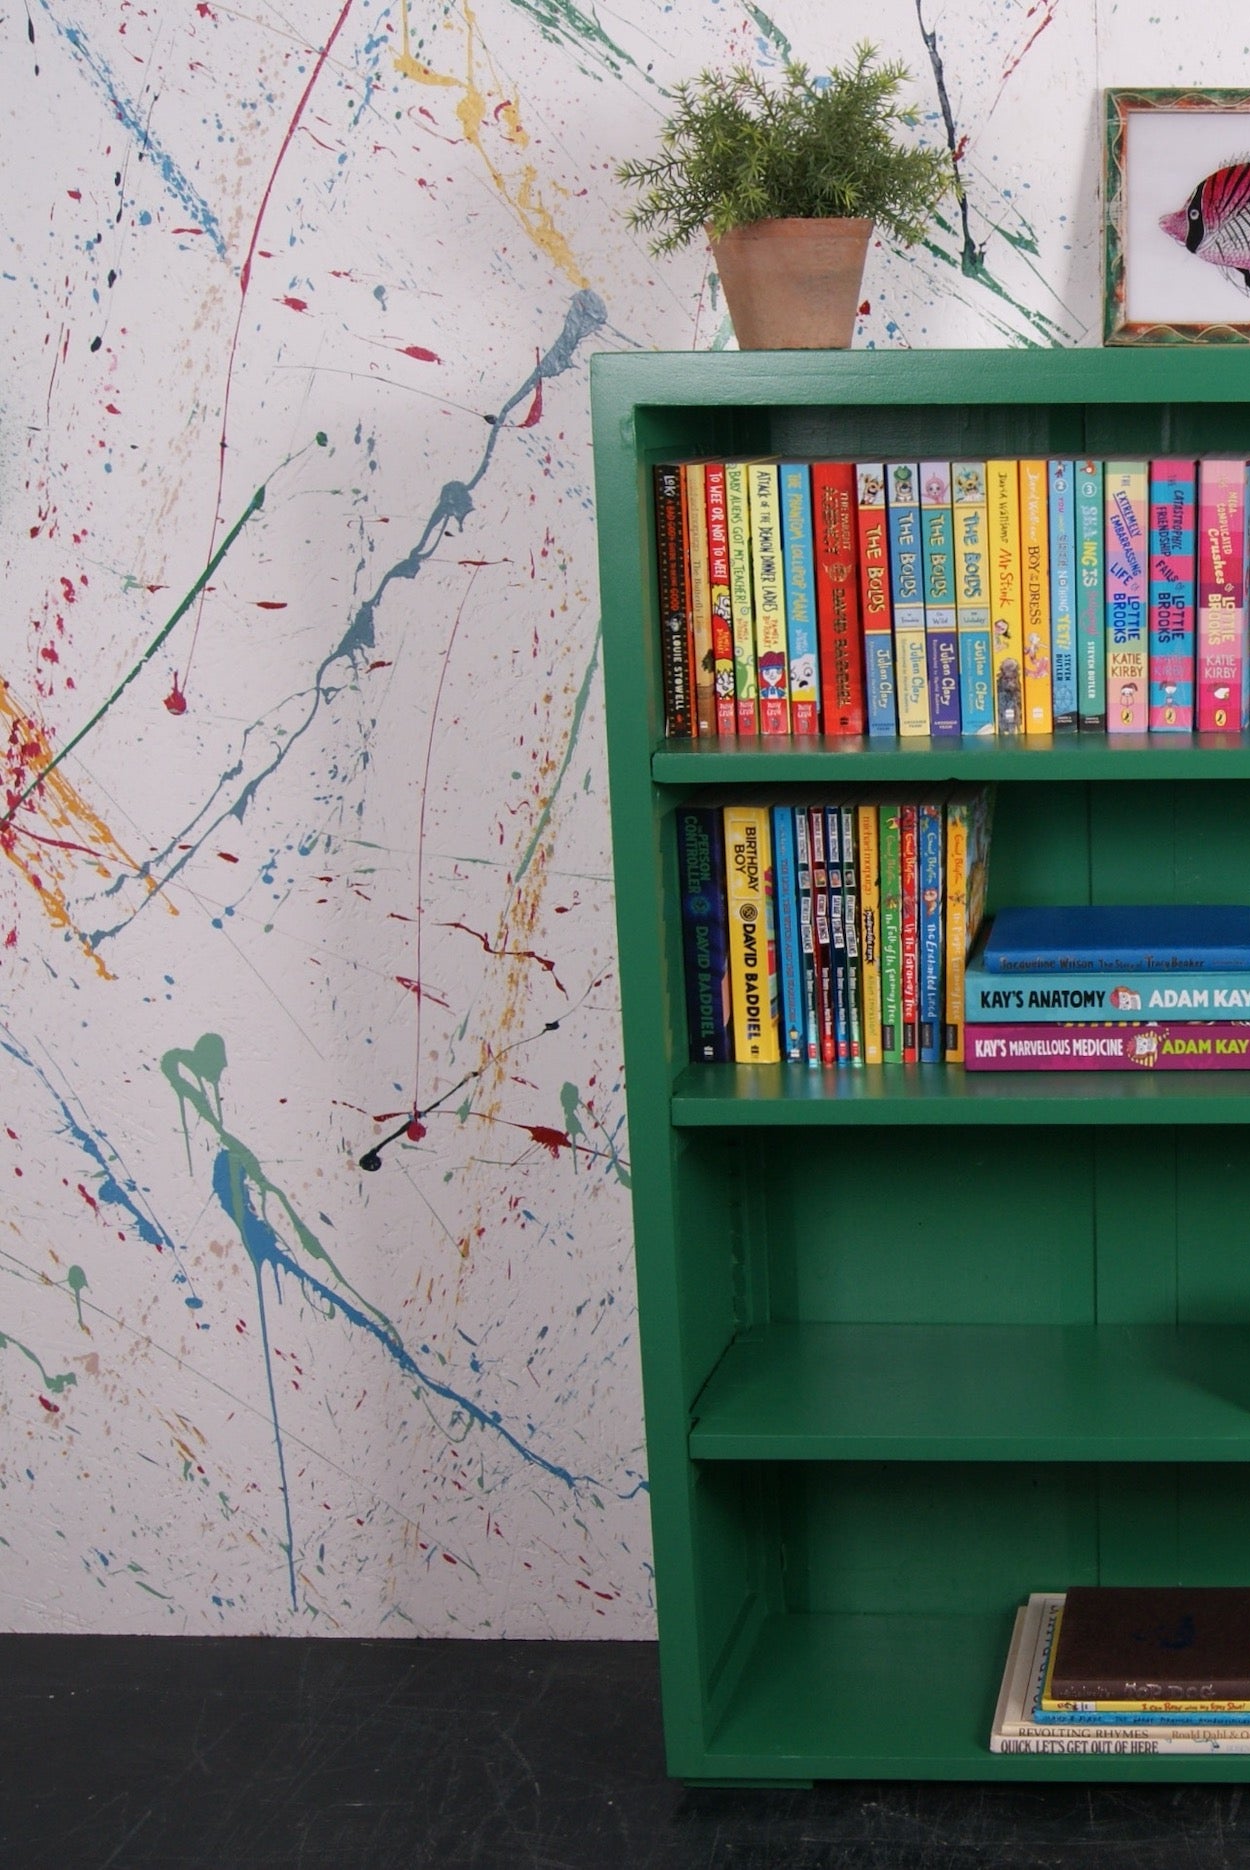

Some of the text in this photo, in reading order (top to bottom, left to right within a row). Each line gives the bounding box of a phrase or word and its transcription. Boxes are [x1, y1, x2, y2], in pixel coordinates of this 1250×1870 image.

[710, 486, 723, 504] WEE
[711, 507, 724, 521] OR
[759, 512, 771, 522] THE
[898, 513, 914, 545] THE
[1116, 490, 1141, 537] EXTREMELY
[1171, 490, 1184, 550] CATASTROPHIC
[1217, 503, 1233, 555] COMPLICATED
[711, 524, 725, 542] NOT
[728, 471, 748, 604] BABY ALIENS GOT MY TEACHER!
[758, 527, 774, 552] DEMON
[1110, 515, 1141, 576] EMBARRASSING
[1156, 507, 1171, 557] FRIENDSHIP
[714, 559, 727, 578] WEE!
[760, 555, 776, 582] DINNER
[864, 525, 885, 614] THE BOLDS
[929, 515, 947, 599] THE BOLDS
[963, 511, 982, 598] THE BOLDS
[1028, 546, 1040, 572] BOY
[1208, 528, 1226, 584] Crushes
[899, 553, 917, 598] BOLDS
[998, 548, 1015, 607] Mr Stink
[1083, 568, 1098, 587] IS
[1110, 562, 1133, 586] LIFE
[1155, 560, 1179, 582] FAILS
[671, 588, 680, 611] GOOD
[762, 585, 777, 612] LADIES
[1028, 583, 1041, 625] DRESS
[1058, 570, 1069, 612] NOTHING
[1113, 593, 1126, 644] BROOKS
[1127, 596, 1140, 640] LOTTIE
[1158, 592, 1170, 643] BROOKS
[1171, 595, 1185, 641] LOTTIE
[1208, 593, 1221, 644] BROOKS
[1222, 596, 1236, 641] LOTTIE
[672, 634, 684, 710] LOUIE STOWELL
[876, 649, 892, 680] Julian
[909, 642, 924, 674] Julian
[940, 643, 955, 675] Julian
[1087, 641, 1096, 699] STEVEN BUTLER
[1111, 666, 1144, 678] KIRBY
[1112, 653, 1142, 665] KATIE
[1204, 667, 1237, 679] KIRBY
[1206, 655, 1236, 666] KATIE
[910, 677, 924, 704] Clary
[940, 677, 955, 705] Clary
[974, 641, 987, 711] Julian Clary
[879, 682, 892, 708] Clary
[863, 816, 873, 850] michael
[685, 815, 702, 894] CONTROLLER
[699, 833, 711, 880] PERSON
[734, 843, 746, 874] BOY
[744, 826, 759, 892] BIRTHDAY
[904, 833, 916, 884] Enid Blyton
[924, 832, 937, 884] Enid Blyton
[953, 834, 963, 884] Enid Blyton
[887, 925, 897, 943] Folk
[905, 923, 914, 933] Up
[884, 945, 896, 954] of
[926, 924, 937, 990] The Enchanted
[1000, 955, 1056, 970] Jacqueline
[1059, 957, 1093, 969] Wilson
[1171, 957, 1204, 967] Beaker
[695, 926, 714, 1038] DAVID BADDIEL
[742, 923, 761, 1039] DAVID BADDIEL
[885, 968, 896, 1001] Faraway
[904, 953, 915, 995] Faraway
[888, 1005, 896, 1024] Tree
[906, 999, 915, 1017] Tree
[981, 990, 1024, 1008] KAY'S
[1028, 990, 1106, 1008] ANATOMY
[1149, 989, 1208, 1008] ADAM
[975, 1038, 1249, 1058] KAY'S MARVELLOUS MEDICINE ADAM KAY
[1018, 1728, 1149, 1739] REVOLTING RHYMES
[1036, 1740, 1065, 1754] LET'S
[1067, 1740, 1088, 1754] GET
[1091, 1740, 1113, 1753] OUT
[1115, 1740, 1129, 1753] OF
[1131, 1740, 1159, 1753] HERE
[1171, 1730, 1201, 1739] Roald
[1203, 1730, 1227, 1739] Dahl
[1229, 1731, 1238, 1739] &
